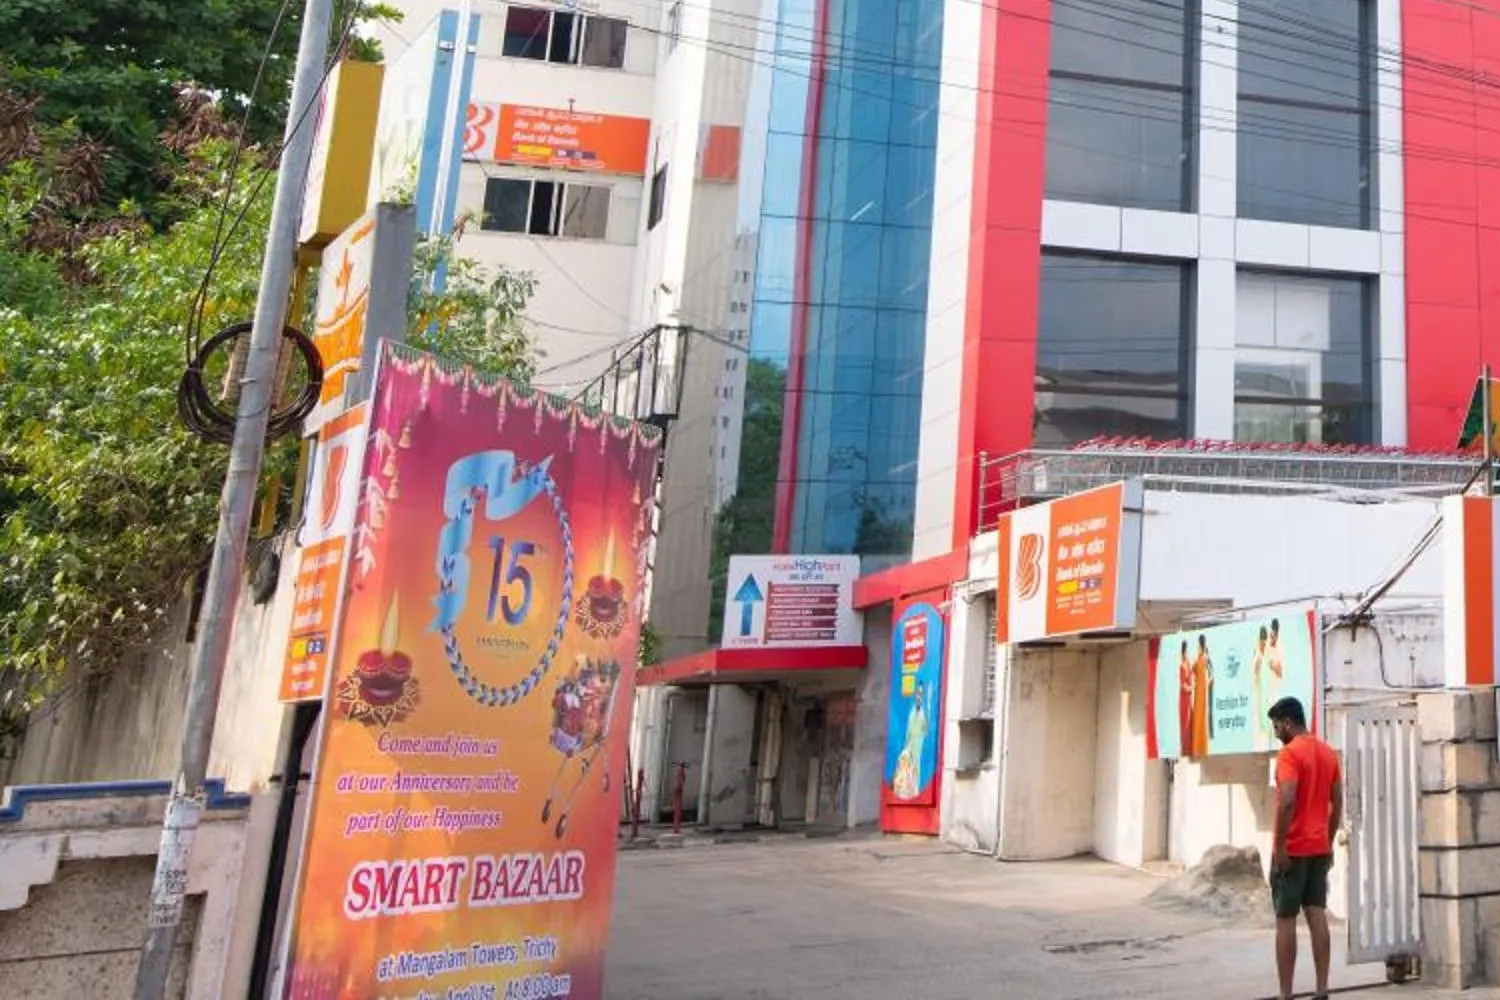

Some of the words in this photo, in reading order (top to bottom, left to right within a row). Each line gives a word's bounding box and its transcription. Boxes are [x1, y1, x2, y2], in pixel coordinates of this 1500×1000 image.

[487, 535, 535, 627] 15
[377, 731, 421, 753] Come
[424, 735, 450, 753] and
[451, 736, 479, 758] join
[337, 774, 353, 792] at
[359, 776, 387, 792] our
[475, 772, 500, 791] and
[503, 771, 519, 791] be
[345, 813, 382, 837] part
[385, 808, 403, 834] of
[403, 815, 429, 830] our
[433, 807, 503, 833] Happiness
[346, 862, 466, 914] SMART
[470, 854, 584, 904] BAZAAR
[378, 957, 394, 981] at
[397, 948, 469, 977] Mangalam
